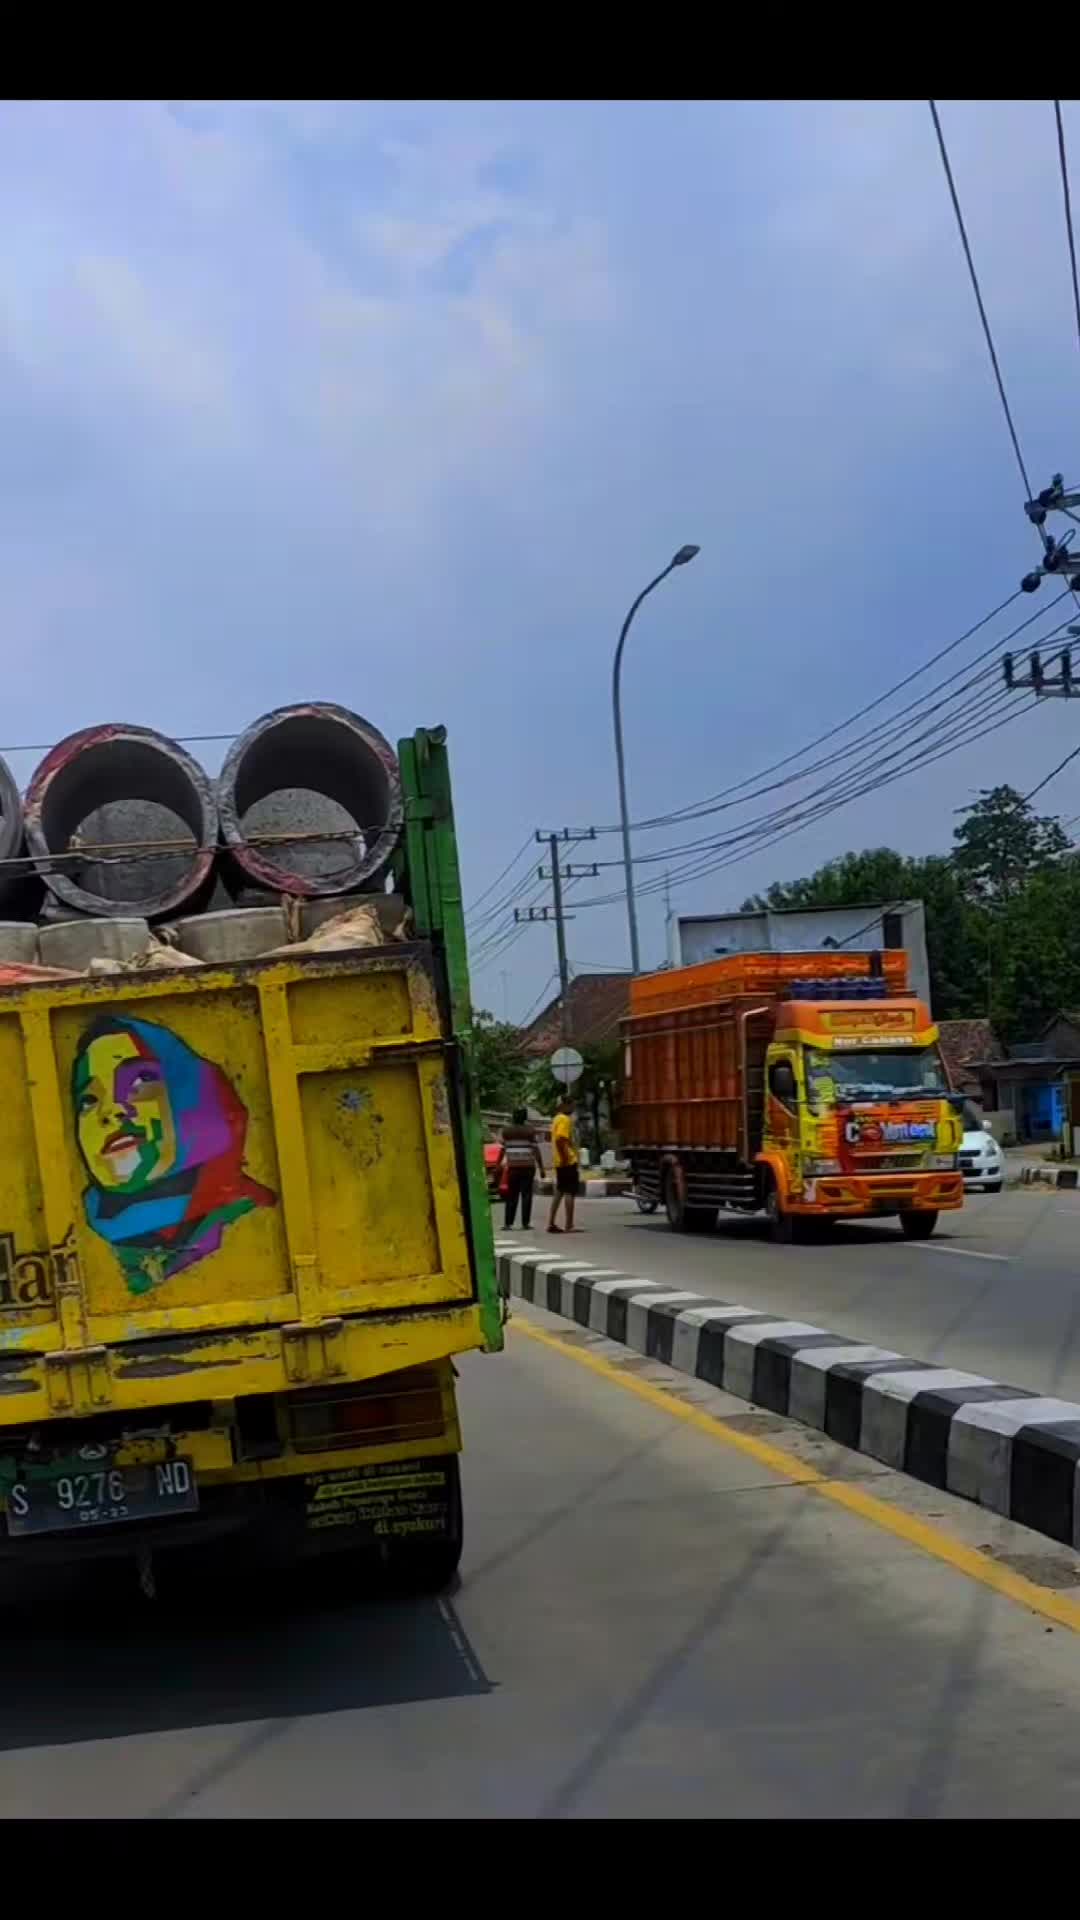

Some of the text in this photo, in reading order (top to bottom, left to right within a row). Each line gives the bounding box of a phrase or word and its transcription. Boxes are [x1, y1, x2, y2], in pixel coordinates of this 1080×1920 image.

[11, 1462, 190, 1515] S 9276 ND
